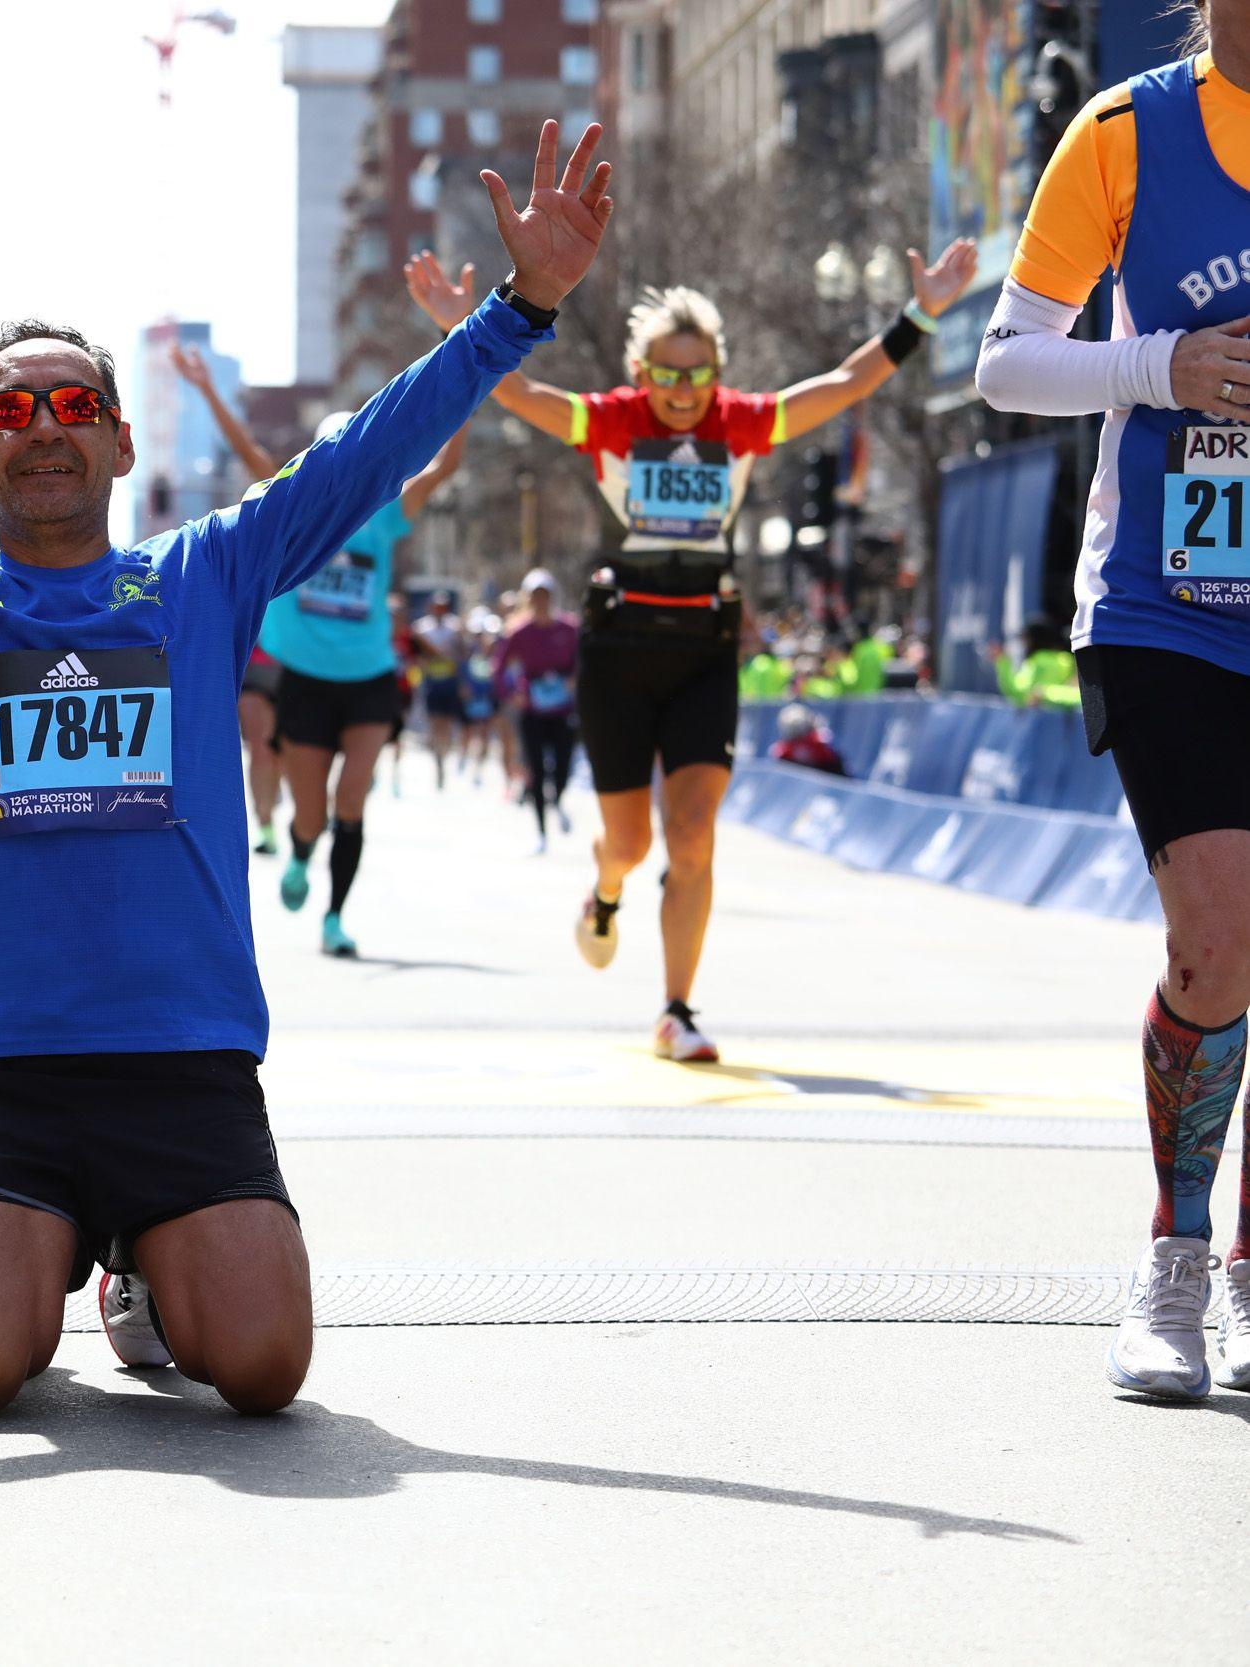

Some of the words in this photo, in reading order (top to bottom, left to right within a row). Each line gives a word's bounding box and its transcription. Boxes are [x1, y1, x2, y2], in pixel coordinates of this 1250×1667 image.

[1188, 431, 1249, 459] ADR
[642, 467, 722, 504] 18535
[1184, 480, 1244, 549] 21
[1170, 550, 1187, 570] 6
[1200, 583, 1229, 593] 126TH
[40, 674, 99, 690] adidas
[10, 794, 37, 806] 126TH
[40, 792, 92, 804] BOSTON
[107, 791, 131, 812] John
[132, 790, 168, 809] Hancock
[11, 803, 93, 817] MARATHON
